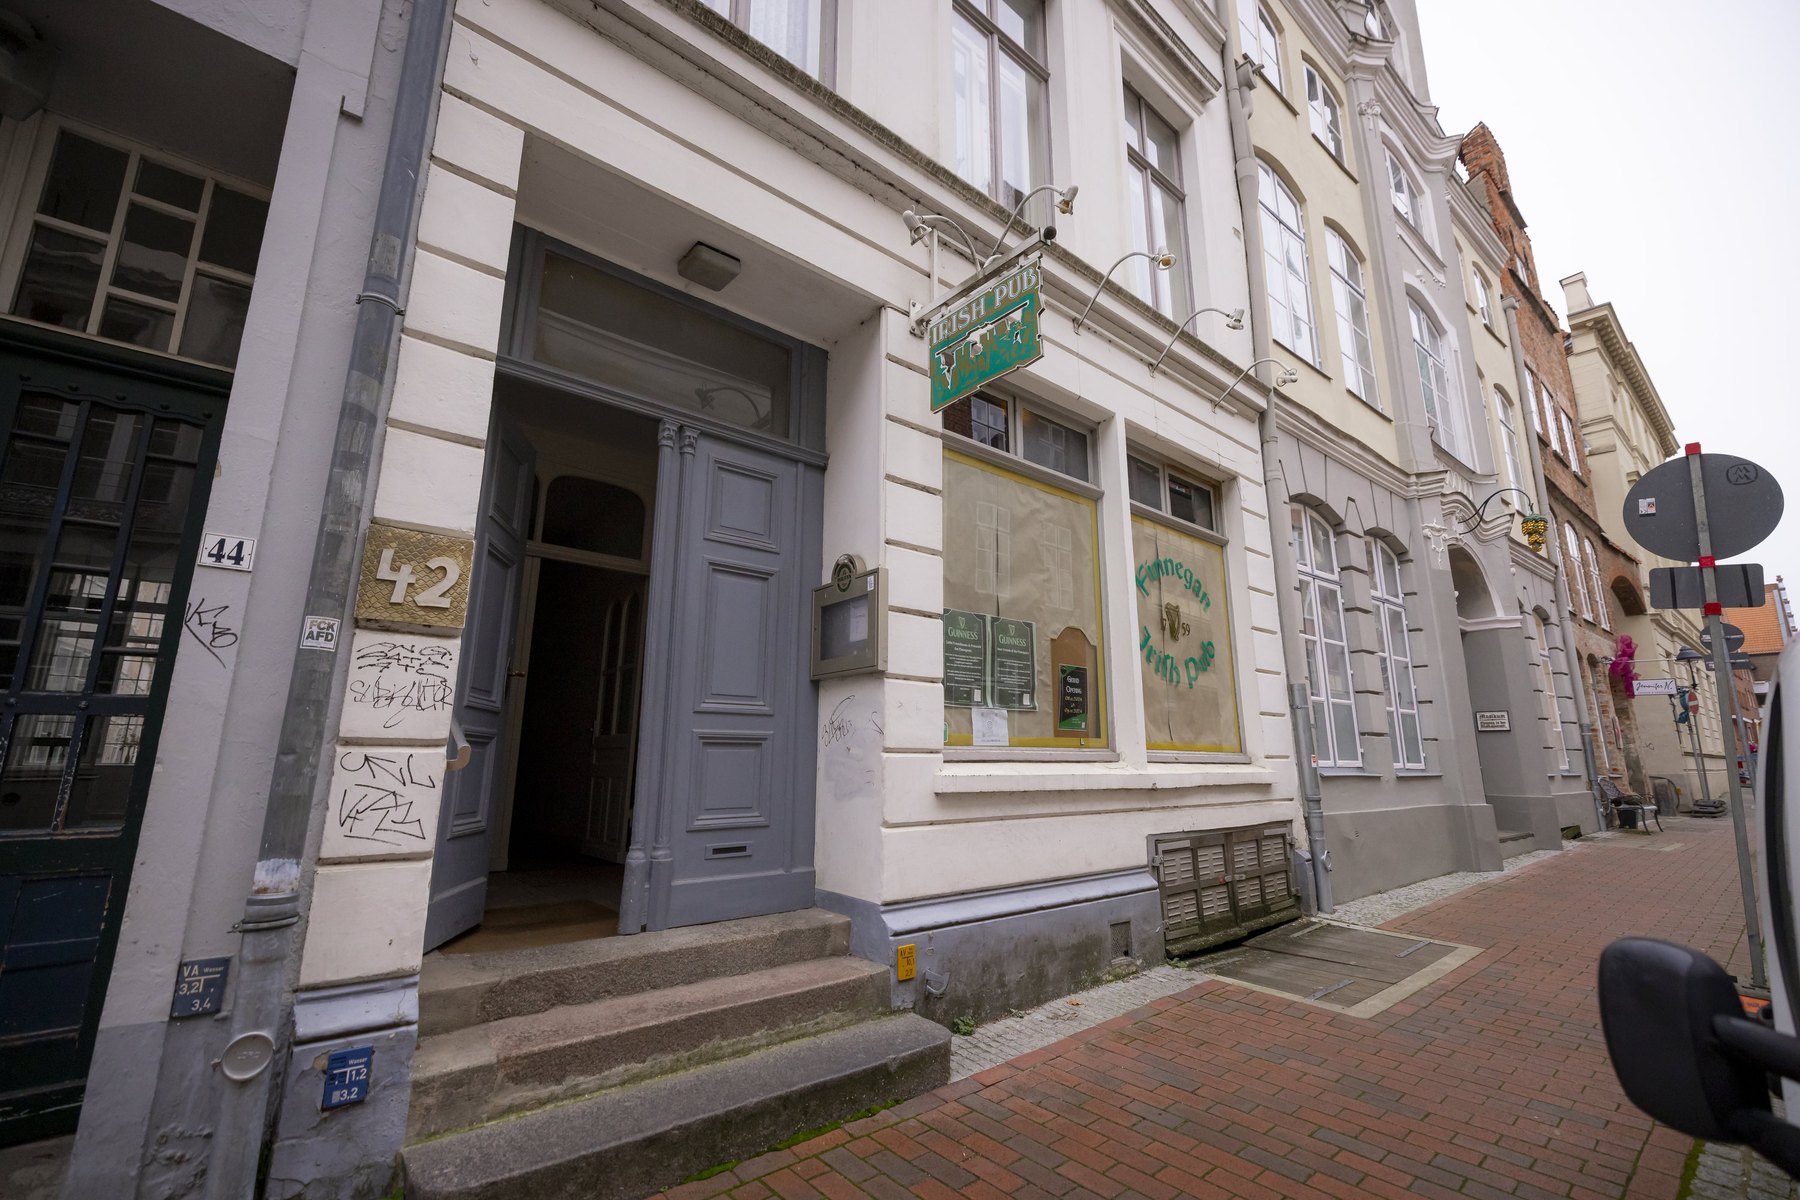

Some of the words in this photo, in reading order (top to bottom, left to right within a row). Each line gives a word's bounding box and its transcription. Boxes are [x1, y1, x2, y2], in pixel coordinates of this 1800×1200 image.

[932, 297, 985, 345] IRISH
[994, 268, 1037, 308] PUB
[207, 538, 244, 566] 44
[376, 548, 460, 609] 42
[1135, 558, 1211, 611] Finnegan
[309, 620, 336, 632] FCK
[1182, 622, 1190, 636] 59
[306, 630, 334, 642] AFD
[948, 627, 978, 640] GUINNESS
[998, 635, 1027, 647] GUINNESS
[183, 965, 198, 978] VA
[179, 982, 198, 996] 3,2
[191, 997, 211, 1012] 3,4
[351, 1068, 367, 1081] 1,2
[340, 1087, 358, 1101] 3,2
